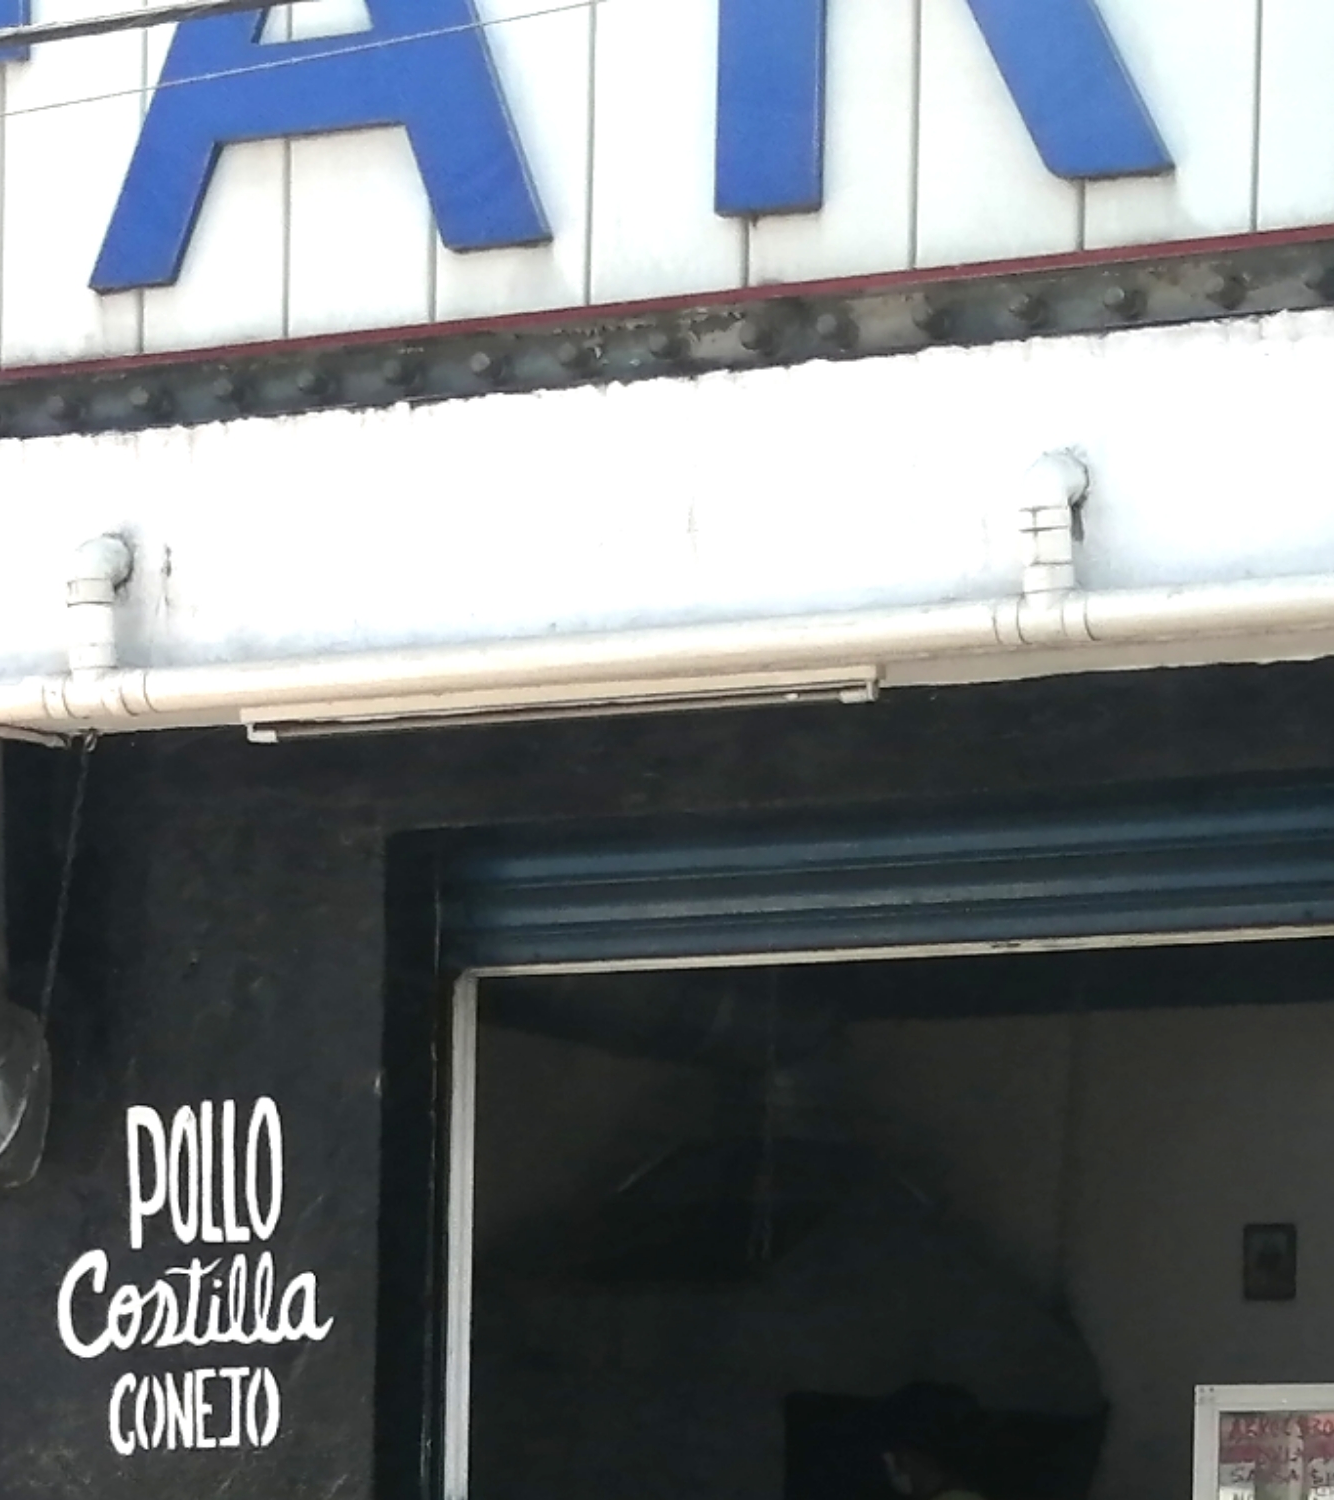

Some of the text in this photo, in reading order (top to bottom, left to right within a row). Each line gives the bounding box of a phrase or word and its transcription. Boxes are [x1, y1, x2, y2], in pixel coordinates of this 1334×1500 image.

[126, 1096, 283, 1249] POLLO
[57, 1248, 335, 1358] Costilla
[109, 1366, 281, 1455] CONEJO
